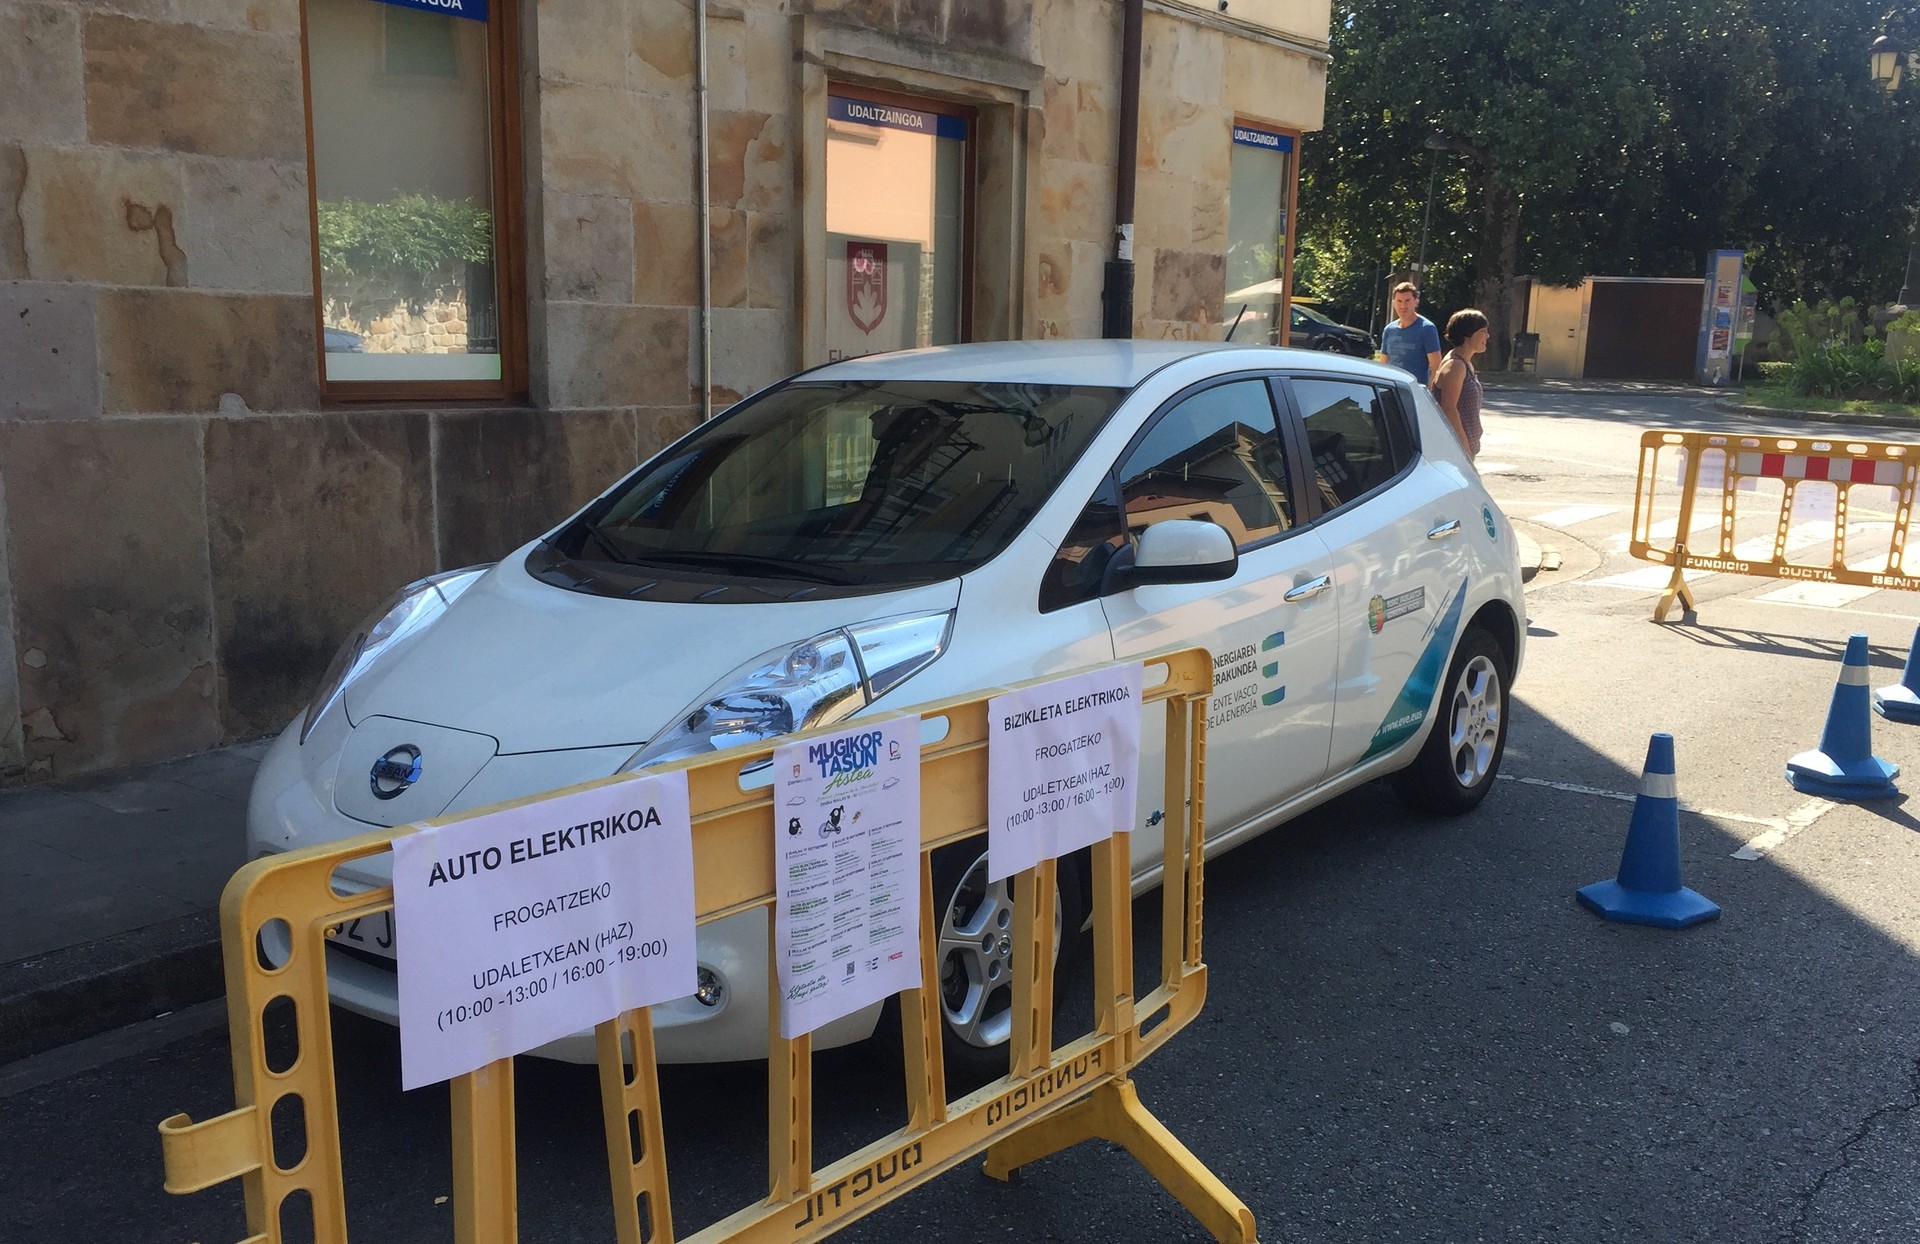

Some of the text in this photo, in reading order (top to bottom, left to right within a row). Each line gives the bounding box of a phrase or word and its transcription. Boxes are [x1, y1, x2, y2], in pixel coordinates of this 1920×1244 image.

[847, 103, 923, 129] UDALTZAINGOA
[1234, 129, 1279, 147] UDALTZAINGOA
[1213, 643, 1257, 670] NERGIAREN
[1004, 686, 1130, 731] BIZIKLETA ELEKTRIKOA
[1213, 683, 1258, 711] ENTE VASCO
[1215, 712, 1225, 726] LA
[809, 730, 882, 763] MUGIKOR
[817, 746, 877, 778] TASUN
[1035, 732, 1102, 761] FROGATZEKO
[376, 762, 412, 779] SSAN
[822, 768, 875, 795] Astea
[1023, 763, 1110, 803] UDALETXEAN (HAZ
[1006, 808, 1034, 831] (10:00
[1073, 788, 1095, 806] 16:00
[428, 806, 662, 887] AUTO ELEKTRIKOA
[493, 882, 611, 932] FROGATZEKO
[473, 921, 634, 990] UDALETXEAN (HAZ)
[437, 996, 493, 1032] (10:00
[562, 958, 605, 985] 16:00
